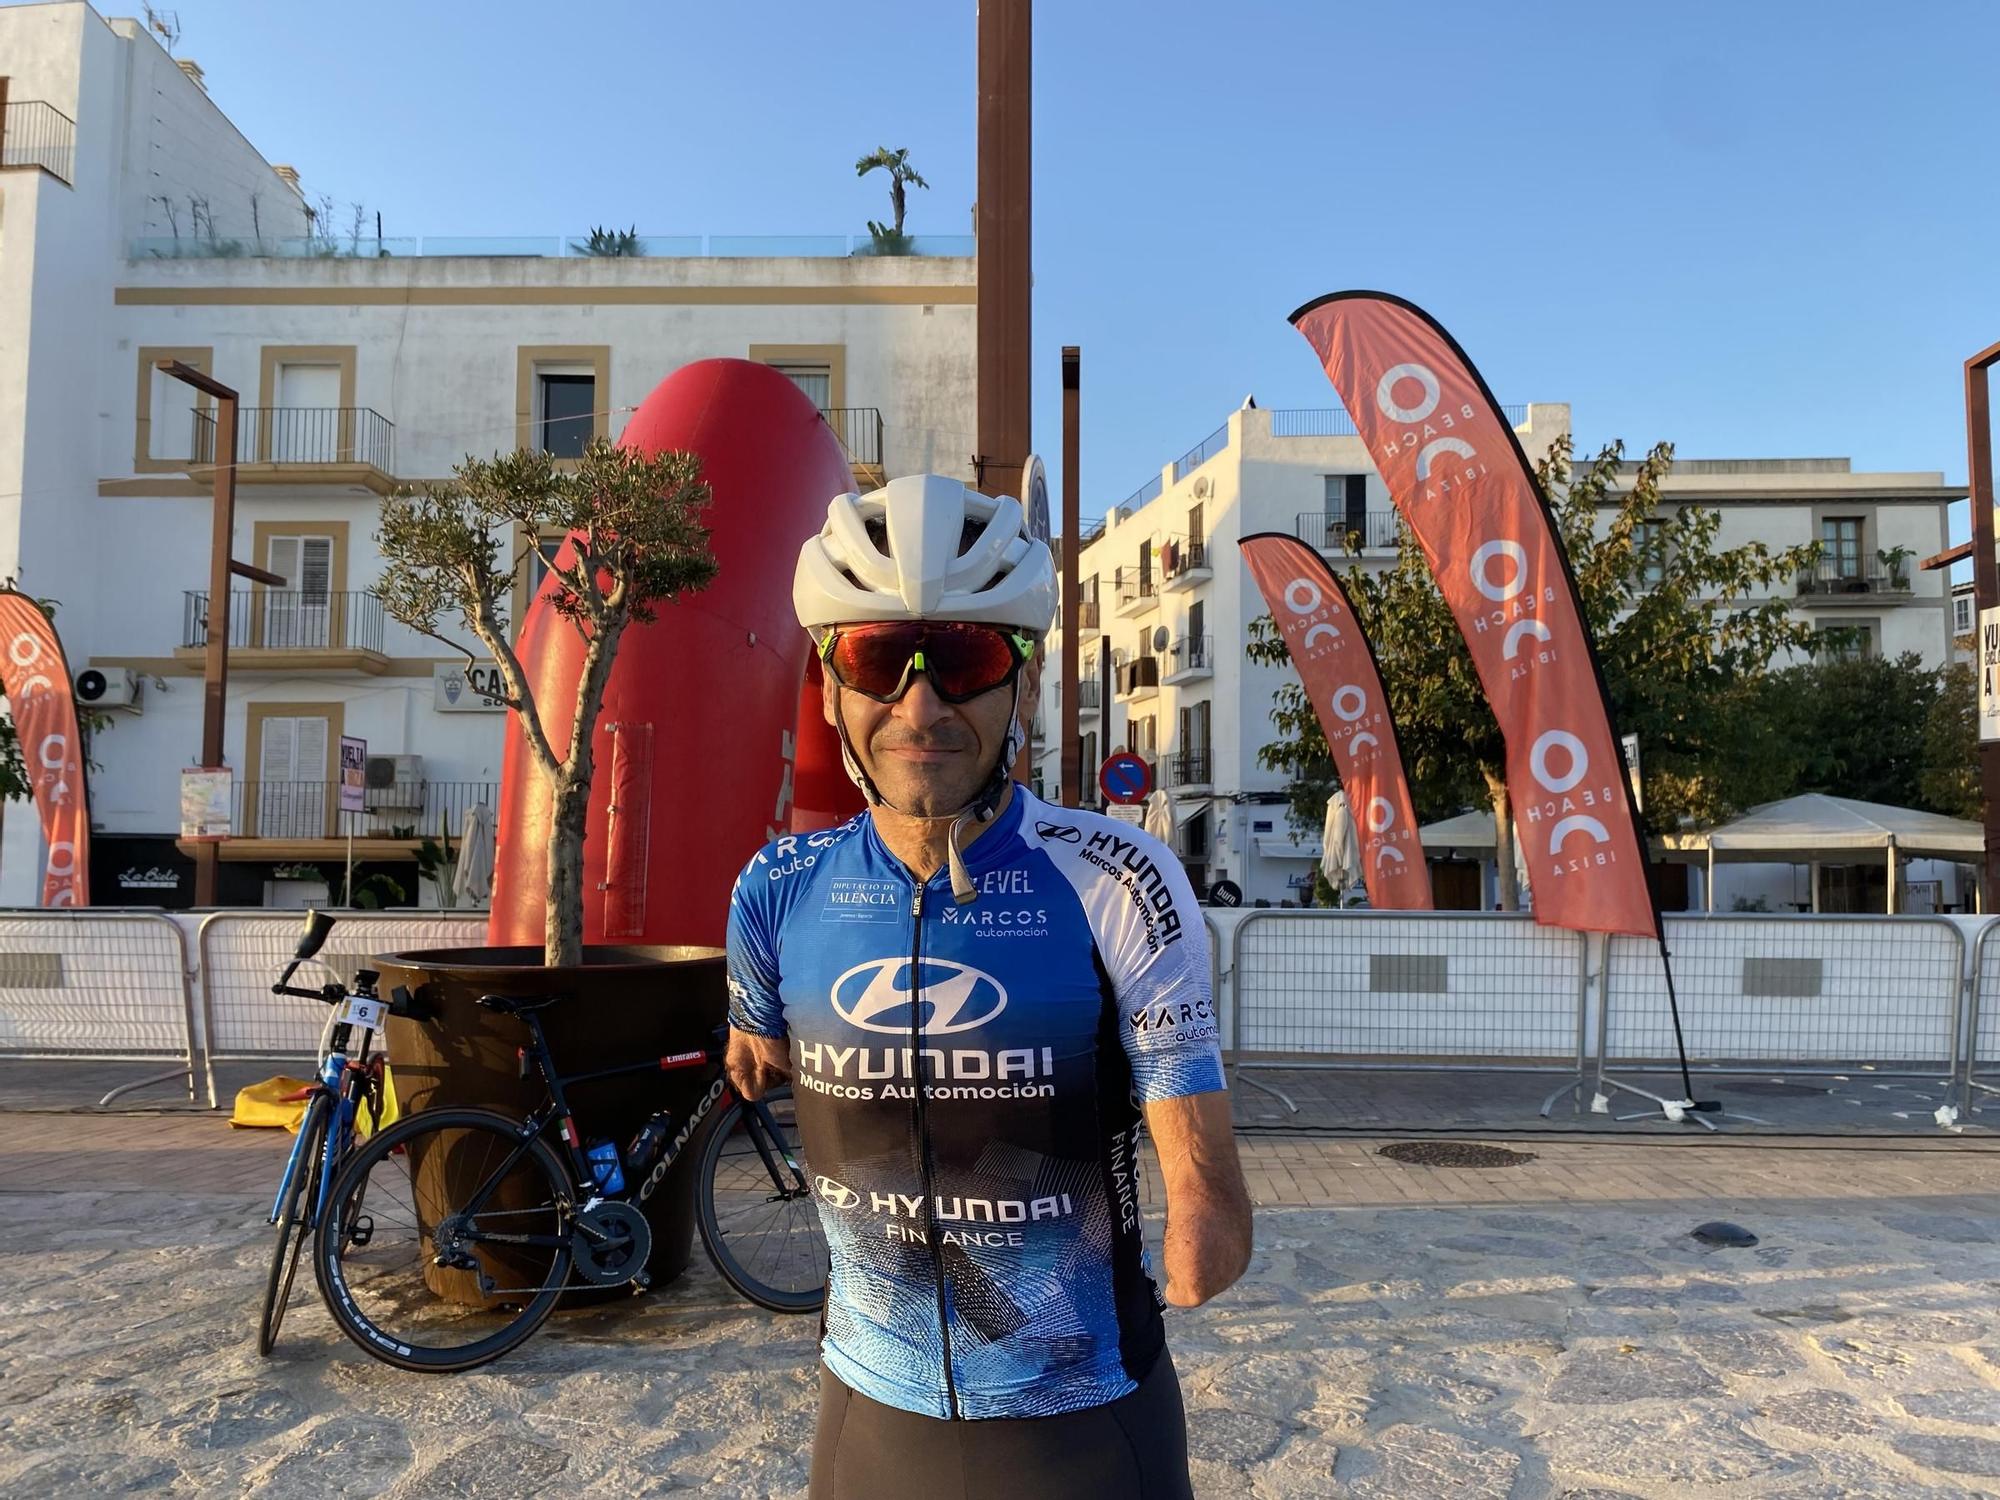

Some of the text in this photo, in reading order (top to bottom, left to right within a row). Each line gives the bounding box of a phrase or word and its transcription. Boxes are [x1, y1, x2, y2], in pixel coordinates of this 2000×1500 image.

[472, 668, 509, 696] CA
[1078, 848, 1122, 881] Marcos
[830, 888, 896, 905] VALÈNCIA
[883, 883, 897, 892] DE
[1087, 831, 1183, 946] HYUNDAI
[1215, 885, 1237, 905] burn
[941, 907, 1047, 925] MARCOS
[975, 927, 1049, 938] automoción
[358, 1006, 369, 1018] 6
[666, 1050, 702, 1064] Emirates
[798, 1038, 1054, 1081] HYUNDAI
[799, 1070, 1056, 1101] Marcos Automoción
[640, 1078, 725, 1201] COLNAGO
[1111, 1130, 1136, 1234] FINANCE
[869, 1192, 1074, 1223] HYUNDAI
[886, 1223, 1025, 1248] FINANCE
